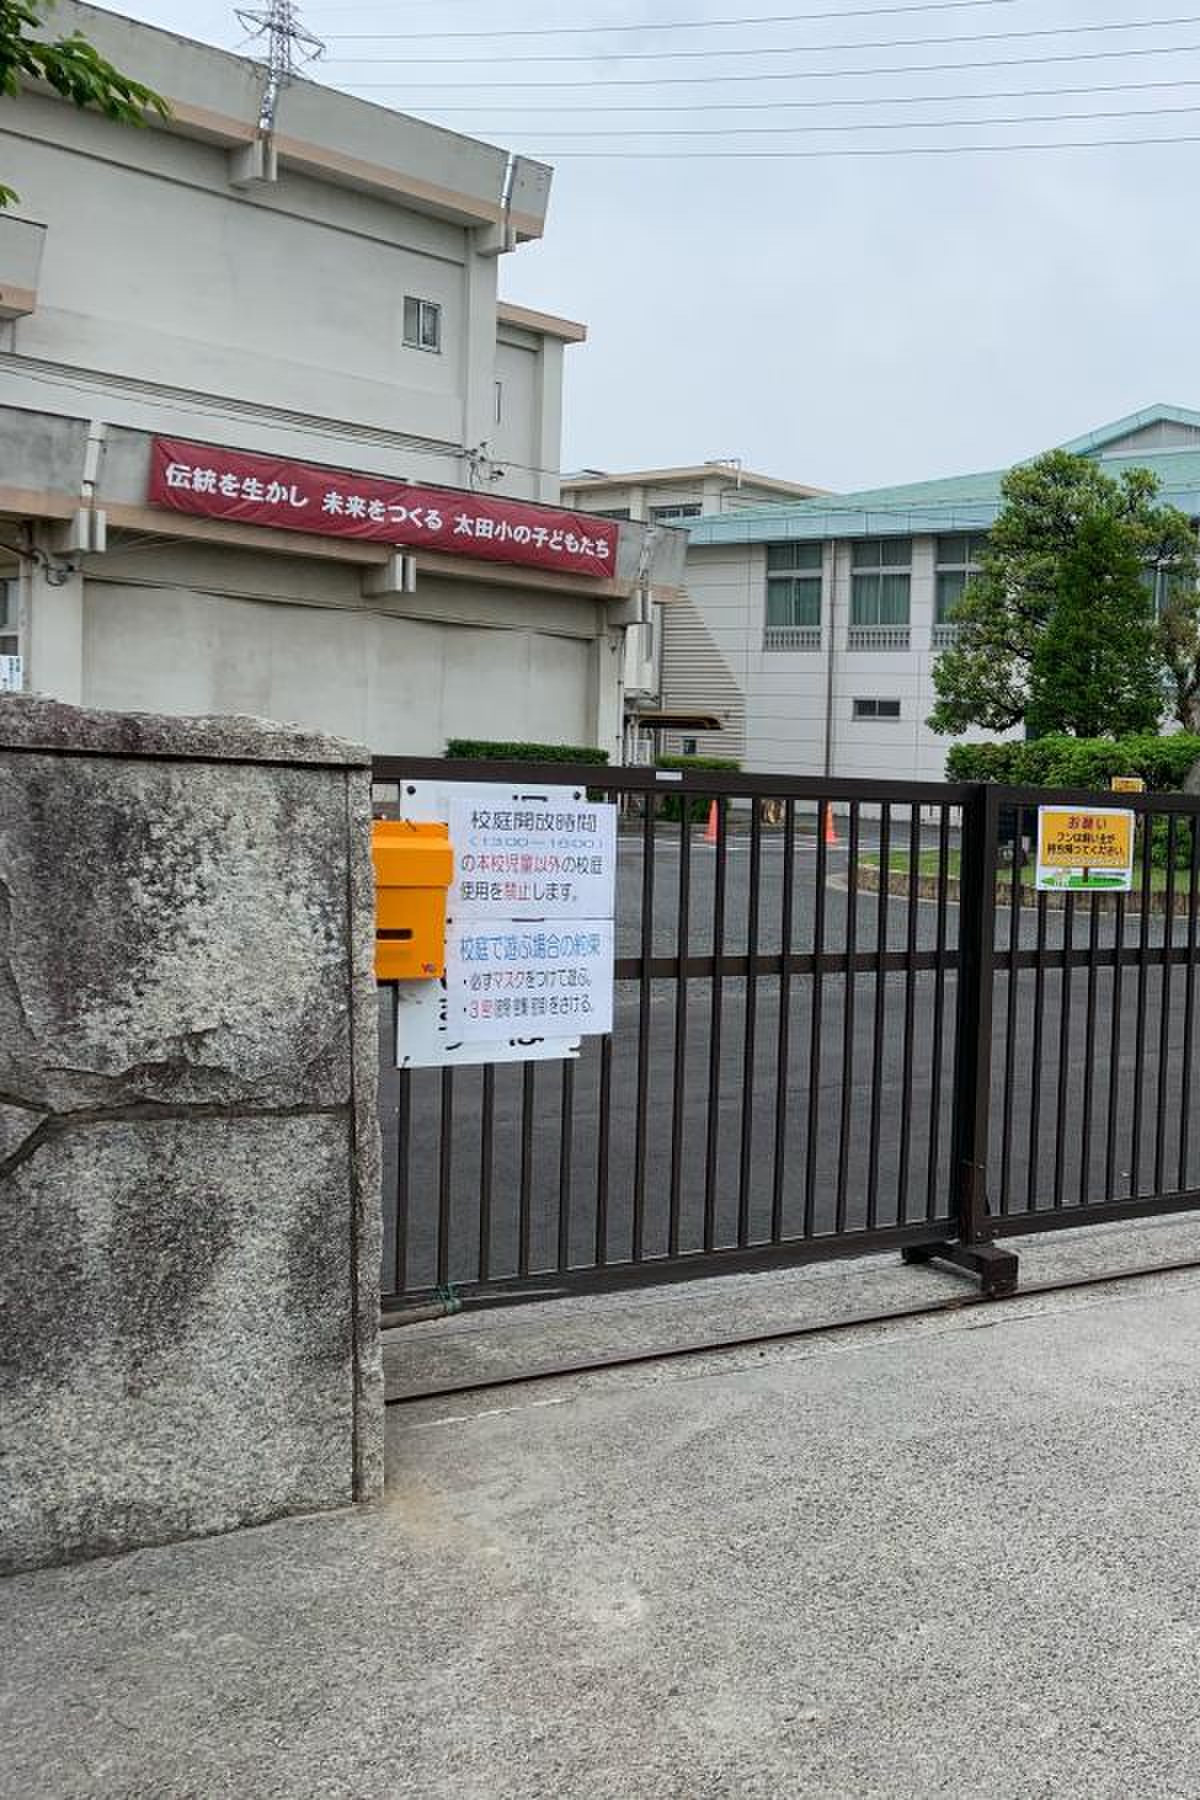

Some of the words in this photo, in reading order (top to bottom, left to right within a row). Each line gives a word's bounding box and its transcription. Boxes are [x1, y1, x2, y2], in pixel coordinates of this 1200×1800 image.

[164, 461, 309, 508] 伝統を生かし
[321, 490, 444, 531] 未来をつくる
[453, 514, 610, 561] 太田小の子どもたち
[472, 809, 597, 833] 校庭開放時間
[461, 880, 578, 902] 使用を禁止します。
[460, 932, 601, 961] 校庭で遊ぶ場合の約束
